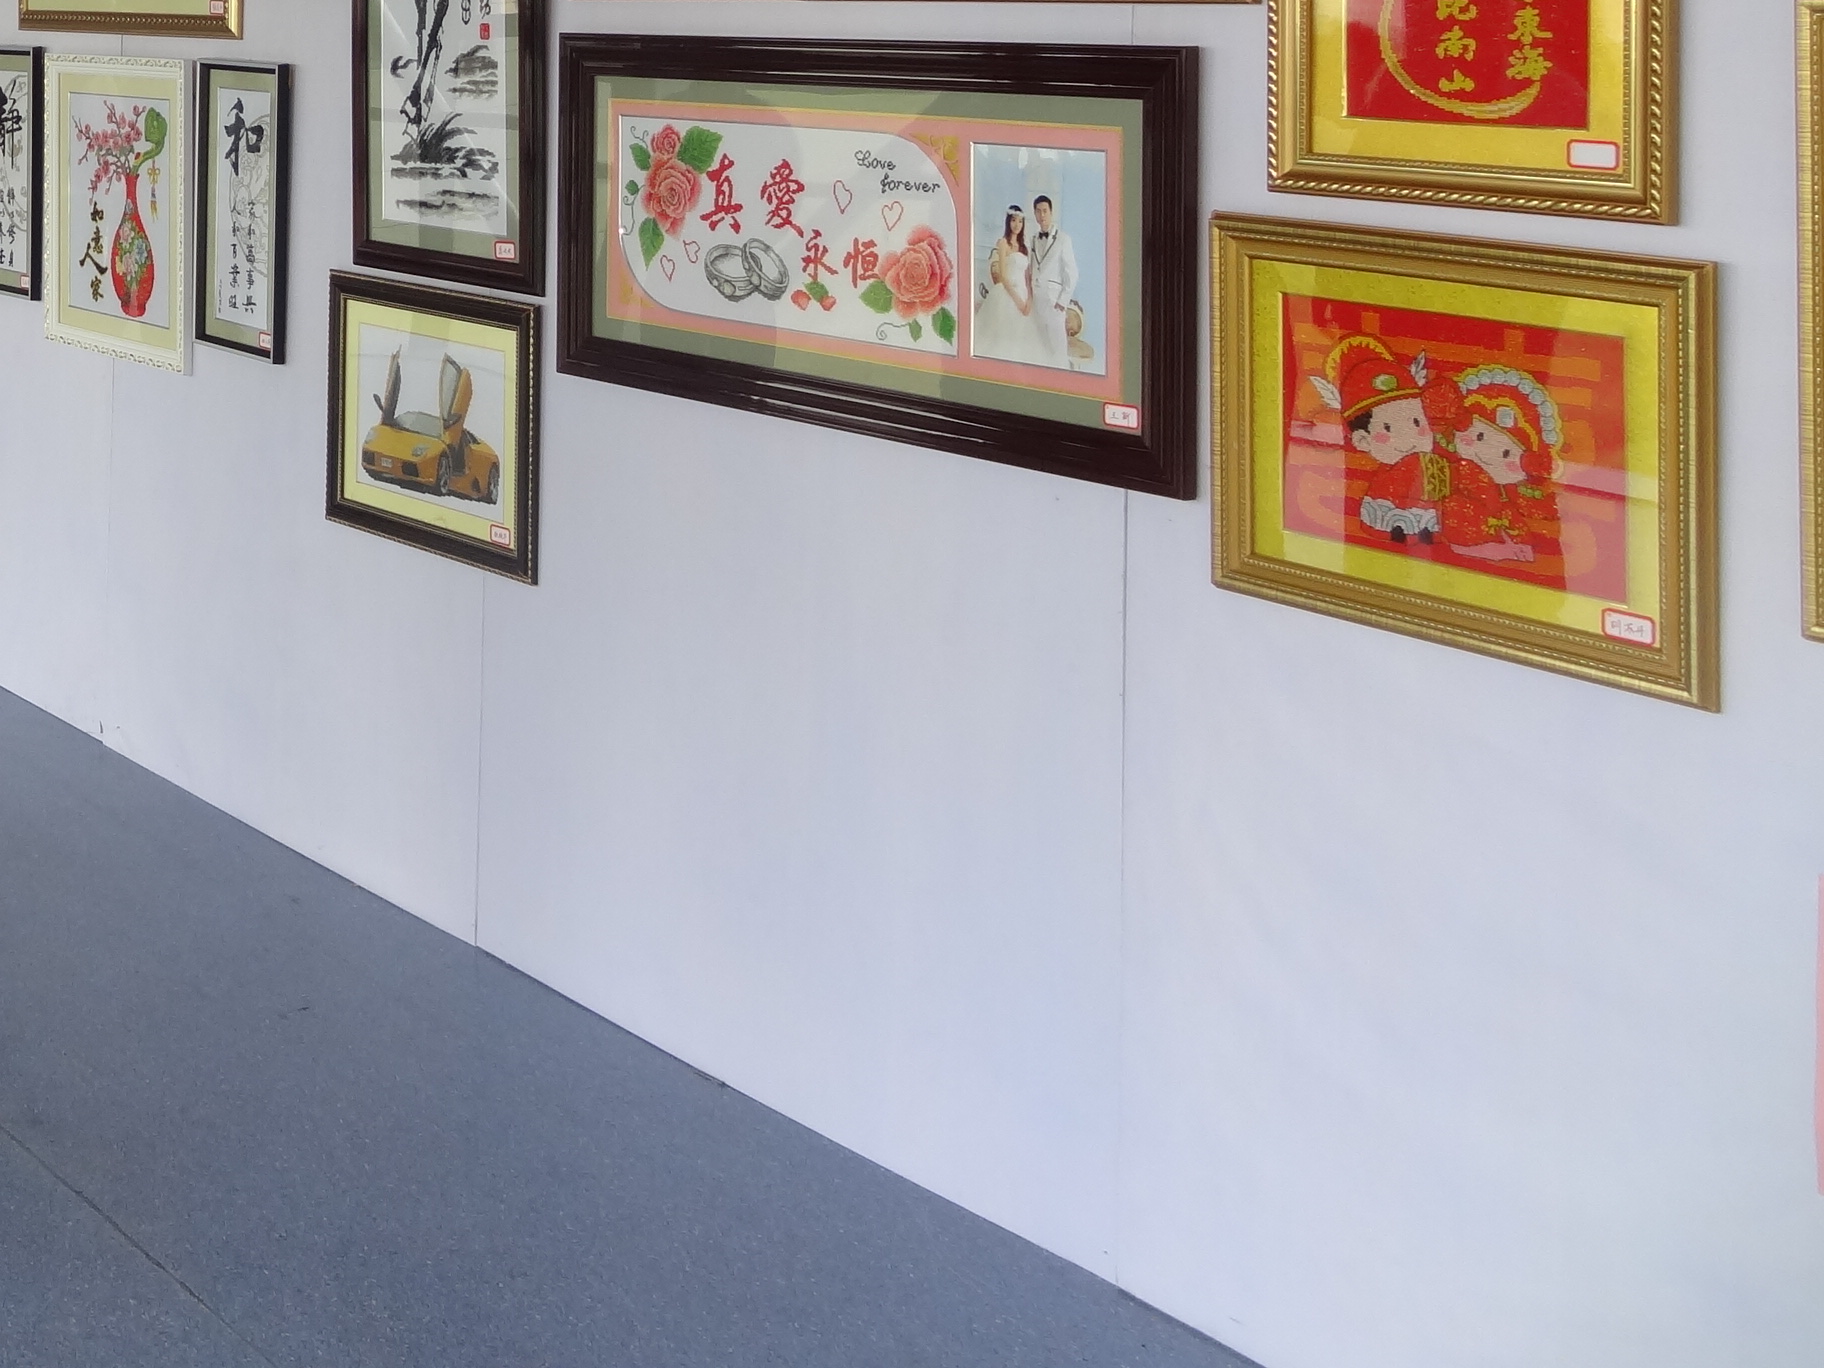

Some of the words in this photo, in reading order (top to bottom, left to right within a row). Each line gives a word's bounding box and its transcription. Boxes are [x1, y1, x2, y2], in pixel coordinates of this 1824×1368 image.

[224, 97, 265, 176] 和
[854, 150, 897, 171] Love
[880, 173, 941, 194] forever
[801, 229, 881, 289] 永恒
